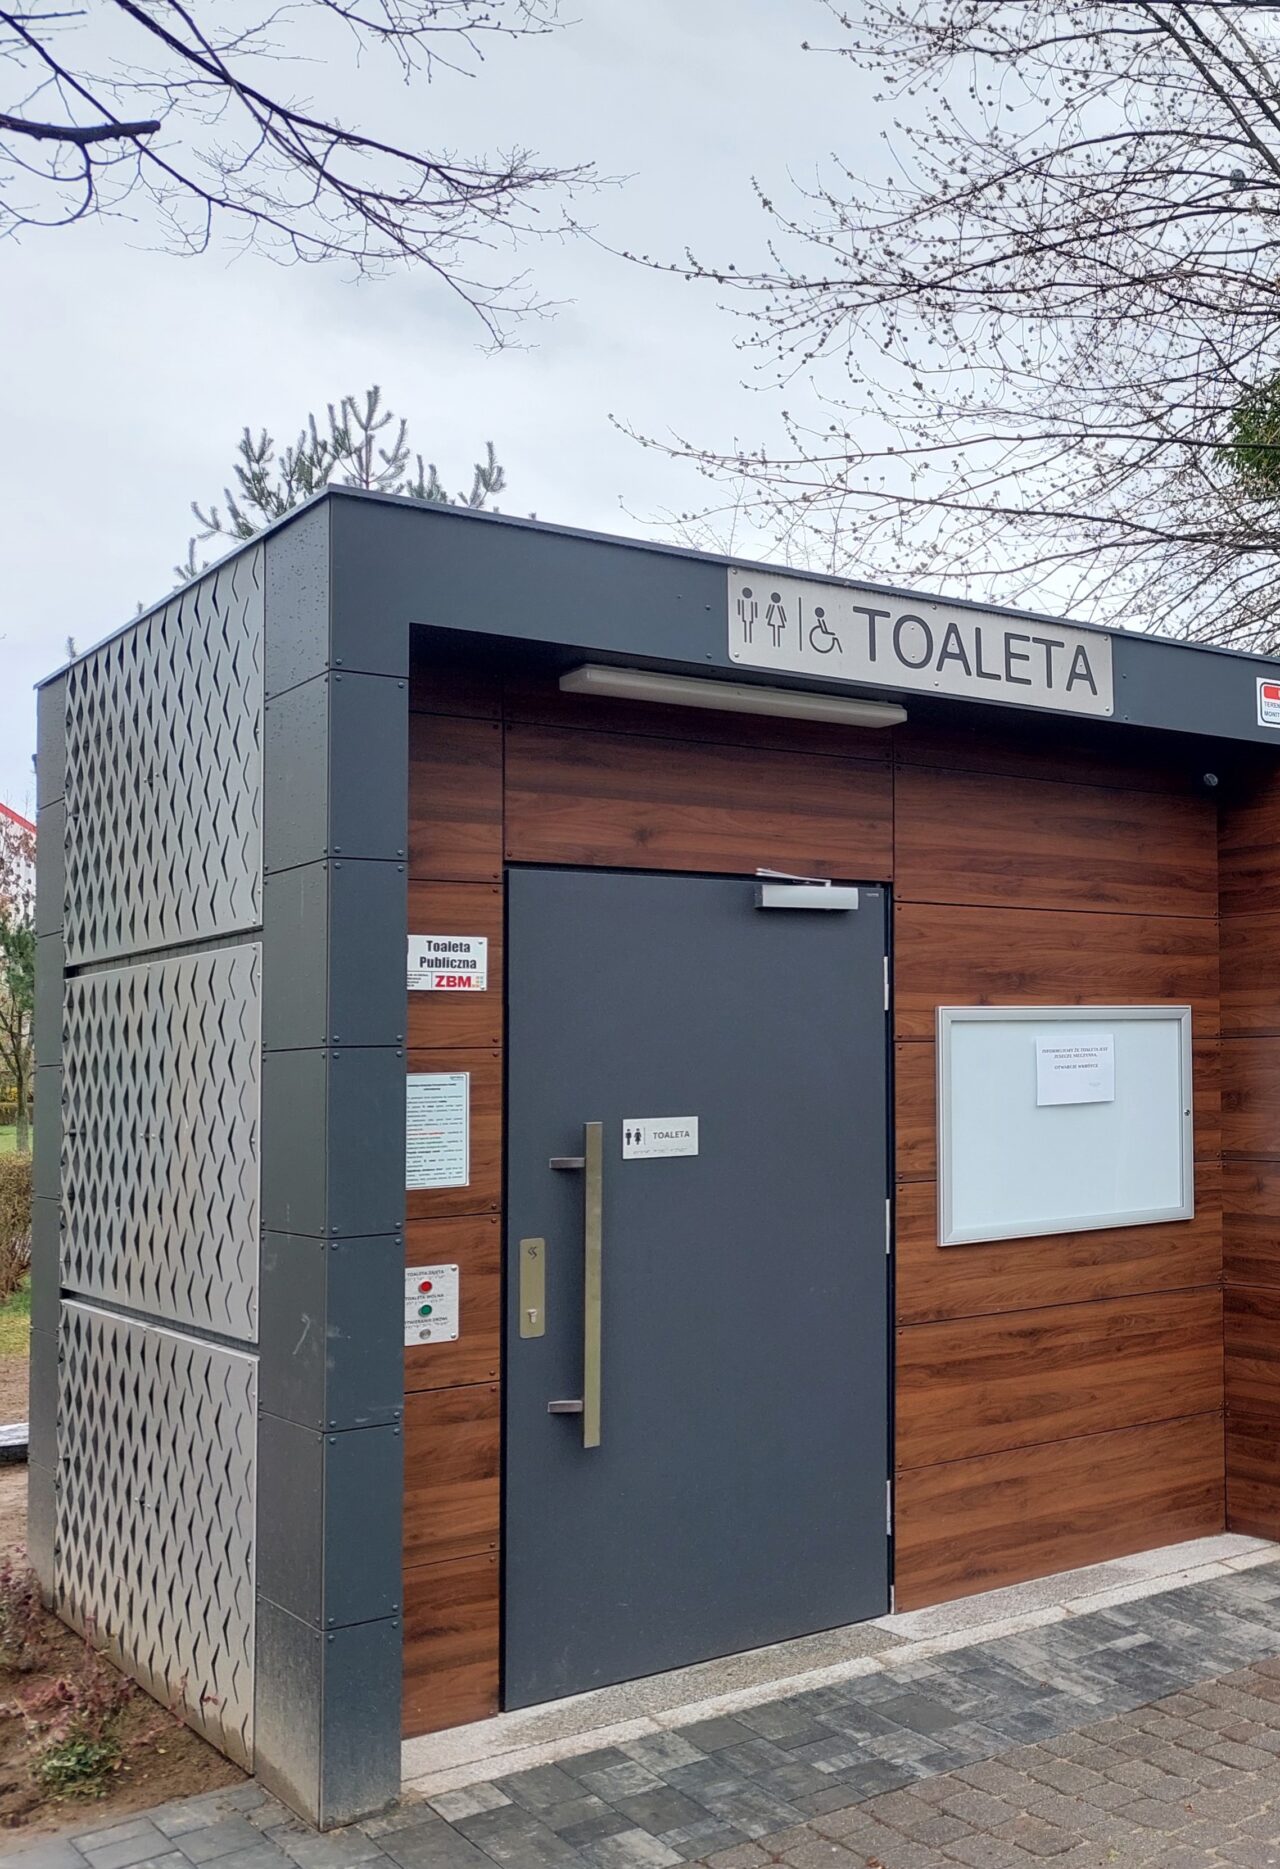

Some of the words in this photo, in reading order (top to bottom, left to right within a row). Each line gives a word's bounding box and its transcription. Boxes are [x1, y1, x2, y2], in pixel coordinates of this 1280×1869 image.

[852, 605, 1098, 697] TOALETA
[426, 940, 471, 953] Toaleta
[419, 956, 477, 969] Publiczna
[435, 975, 472, 988] ZBM
[653, 1130, 690, 1140] TOALETA
